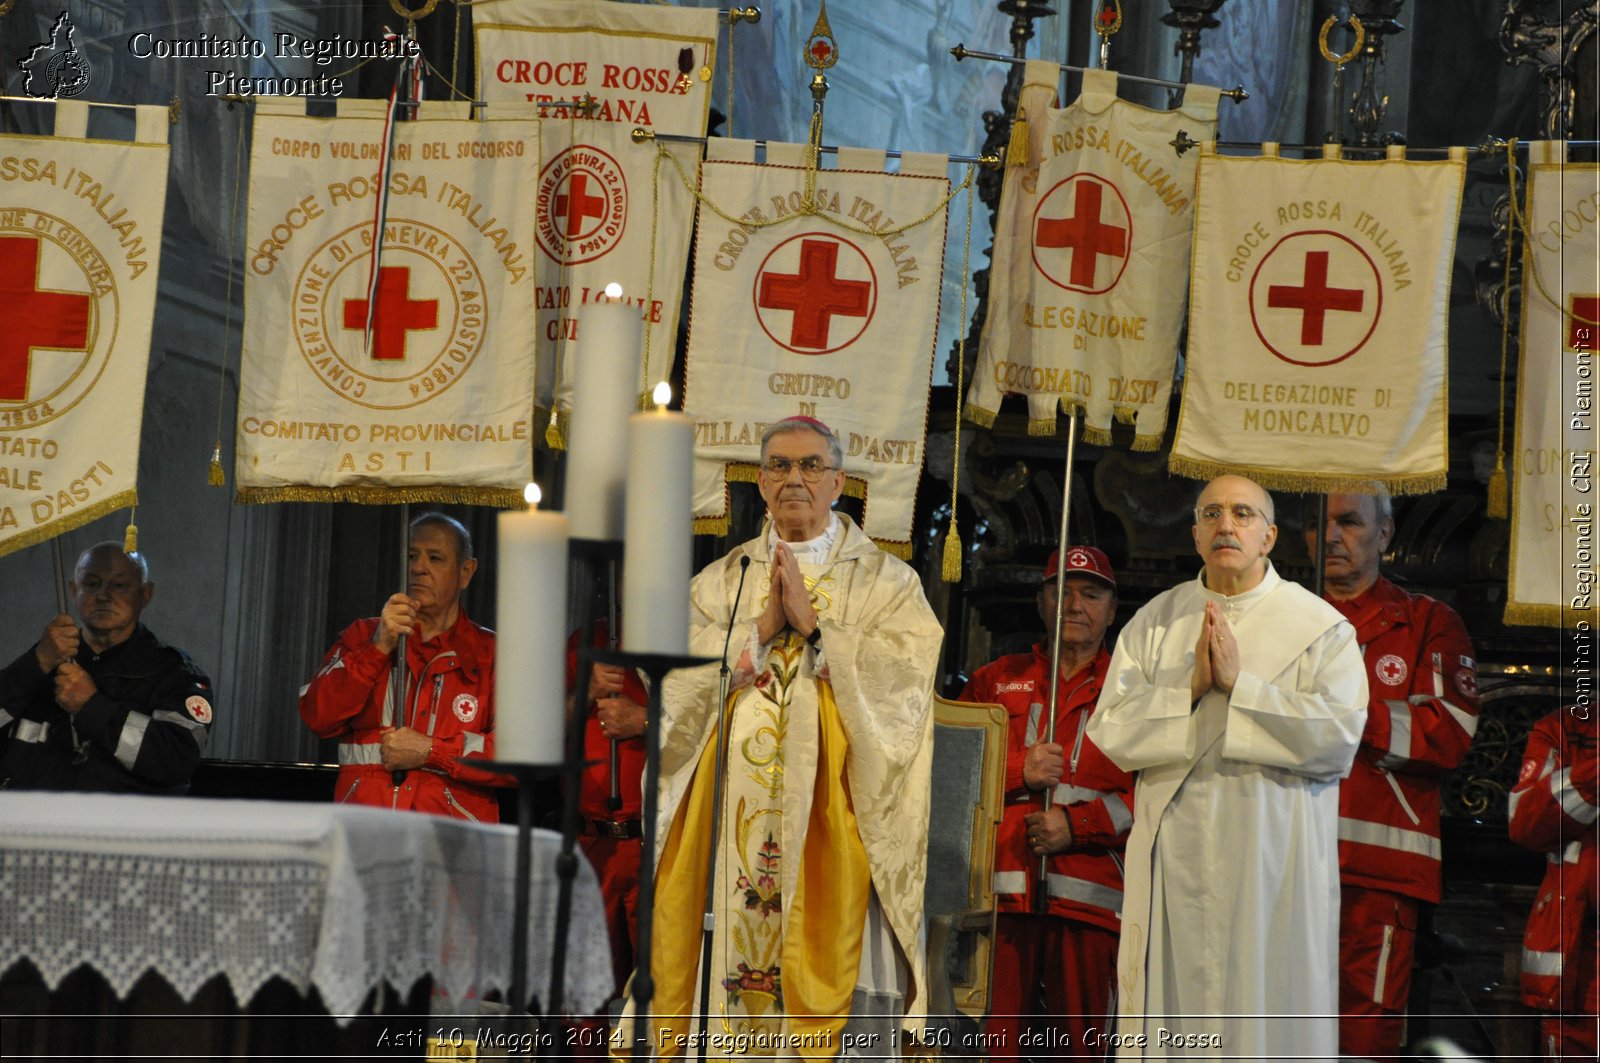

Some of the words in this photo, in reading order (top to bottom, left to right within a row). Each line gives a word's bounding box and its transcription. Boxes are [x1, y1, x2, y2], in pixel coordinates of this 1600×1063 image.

[497, 59, 588, 86] CROCE
[602, 64, 688, 95] ROSSA
[272, 137, 320, 159] CORPO
[330, 142, 411, 160] VOLONARI
[422, 142, 450, 160] DEL
[457, 140, 525, 159] SOCCORSO
[563, 153, 606, 174] GNEVRA
[604, 170, 618, 186] 22
[1051, 125, 1111, 157] ROSSA
[1115, 138, 1189, 215] ITALIANA
[63, 167, 148, 280] ITALIANA
[251, 195, 324, 275] CROCE
[328, 172, 428, 206] ROSSA
[437, 182, 528, 285] ITALIANA
[606, 187, 623, 237] AGOSTO
[360, 226, 449, 261] GNEVRA
[579, 235, 607, 255] 1864
[713, 206, 770, 272] CROCE
[770, 188, 842, 218] ROSA
[1226, 221, 1270, 284] CROCE
[1277, 200, 1342, 225] ROSSA
[1354, 211, 1412, 292] ITALIANA
[32, 214, 54, 233] DI
[56, 225, 113, 298] GINEVRA
[329, 239, 352, 262] DI
[449, 259, 473, 284] 22
[300, 263, 366, 398] CONVENZIONE
[448, 290, 481, 363] AGOSTO
[1073, 333, 1088, 351] DI
[409, 362, 455, 398] 1864
[768, 372, 850, 400] GRUPPO
[994, 360, 1093, 397] COCCONATO
[1108, 376, 1159, 404] D'ASTI
[1223, 381, 1358, 407] DELEGAZIONE
[1375, 388, 1392, 408] DI
[1, 402, 55, 427] 1864
[799, 401, 818, 418] DI
[1243, 408, 1371, 437] MONCALVO
[241, 416, 361, 442] COMITATO
[369, 420, 528, 442] PROVINCIALE
[847, 432, 918, 465] D'ASTI
